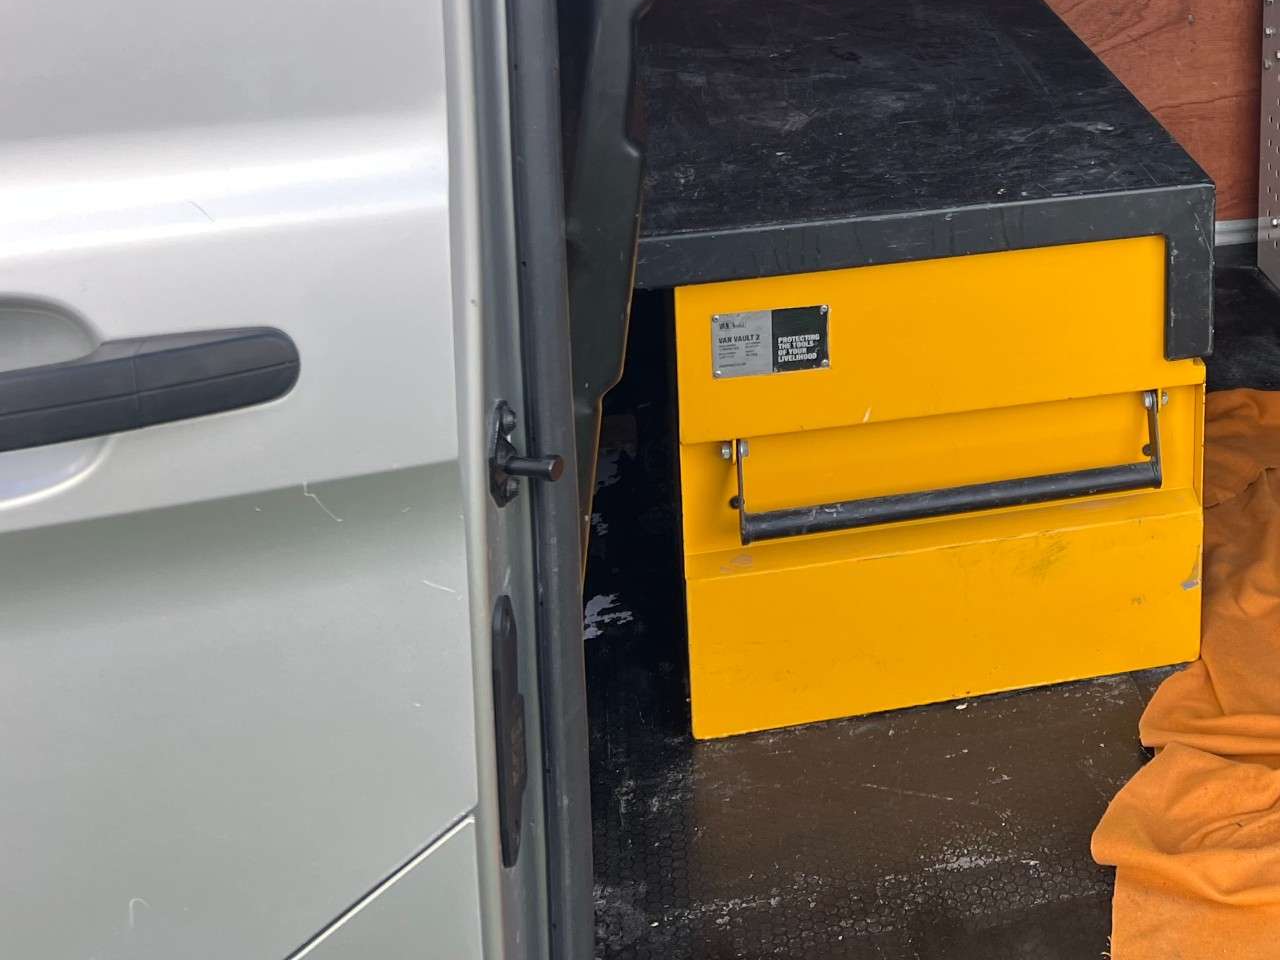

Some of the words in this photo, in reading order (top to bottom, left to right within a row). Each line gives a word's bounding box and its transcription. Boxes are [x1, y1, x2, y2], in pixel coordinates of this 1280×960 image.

[733, 334, 754, 342] VAULT
[778, 333, 820, 344] PROTECTING
[778, 352, 818, 363] LIVELIHOOD
